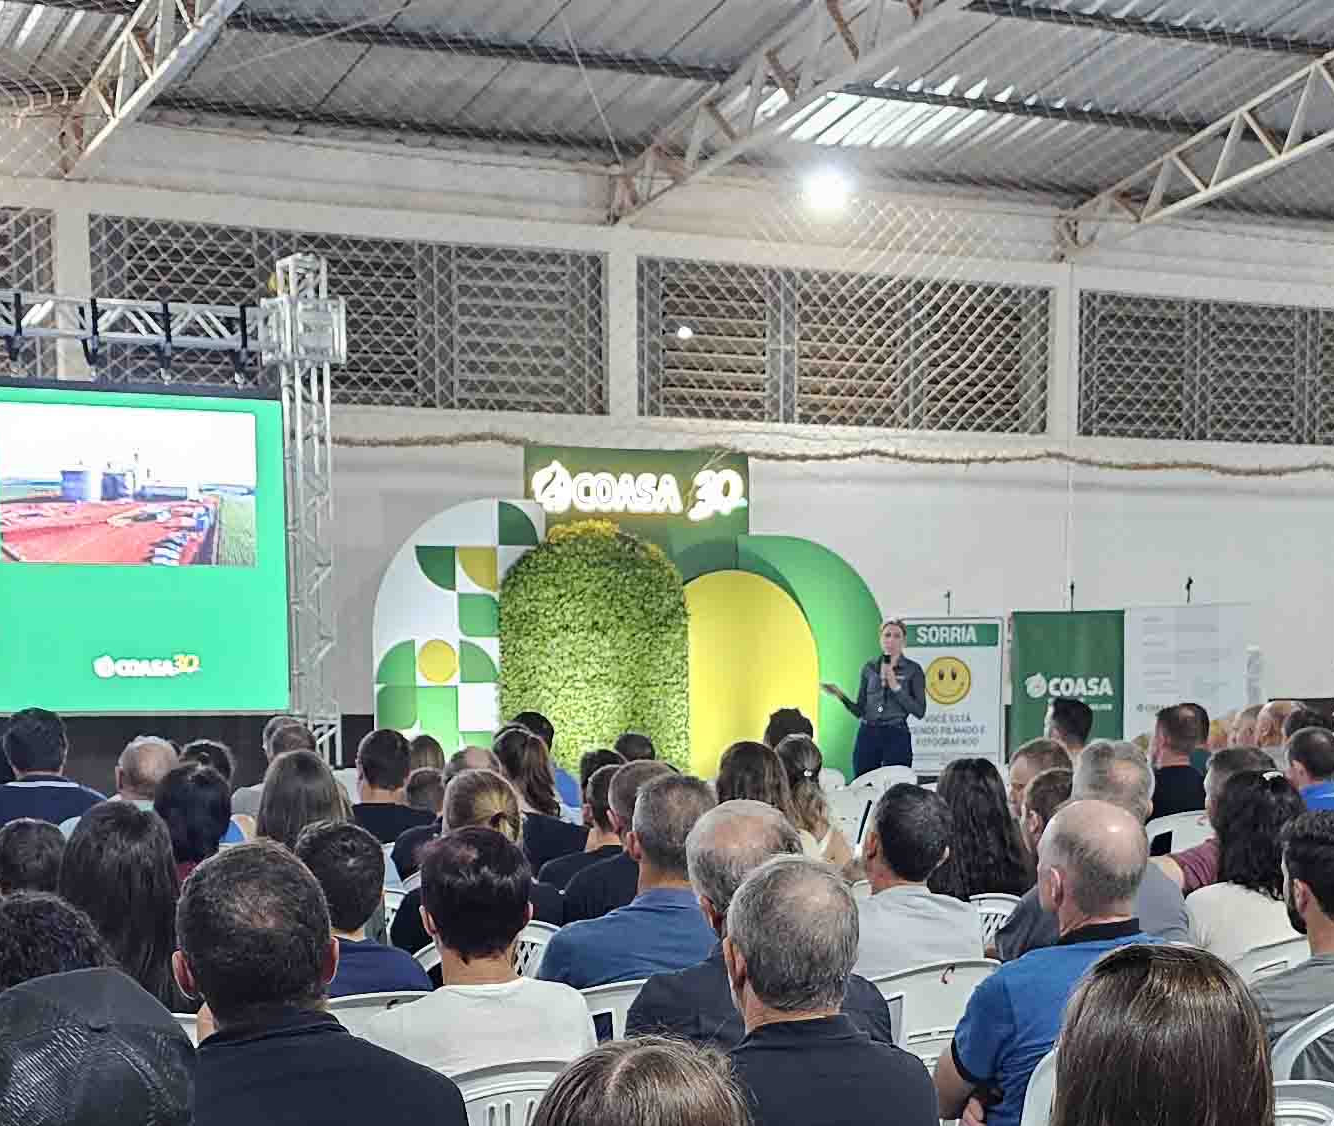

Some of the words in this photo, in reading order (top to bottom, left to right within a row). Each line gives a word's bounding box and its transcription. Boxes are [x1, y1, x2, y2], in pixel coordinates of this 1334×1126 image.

[572, 471, 683, 514] COASA
[916, 624, 979, 644] SORRIA
[1048, 677, 1114, 697] COASA
